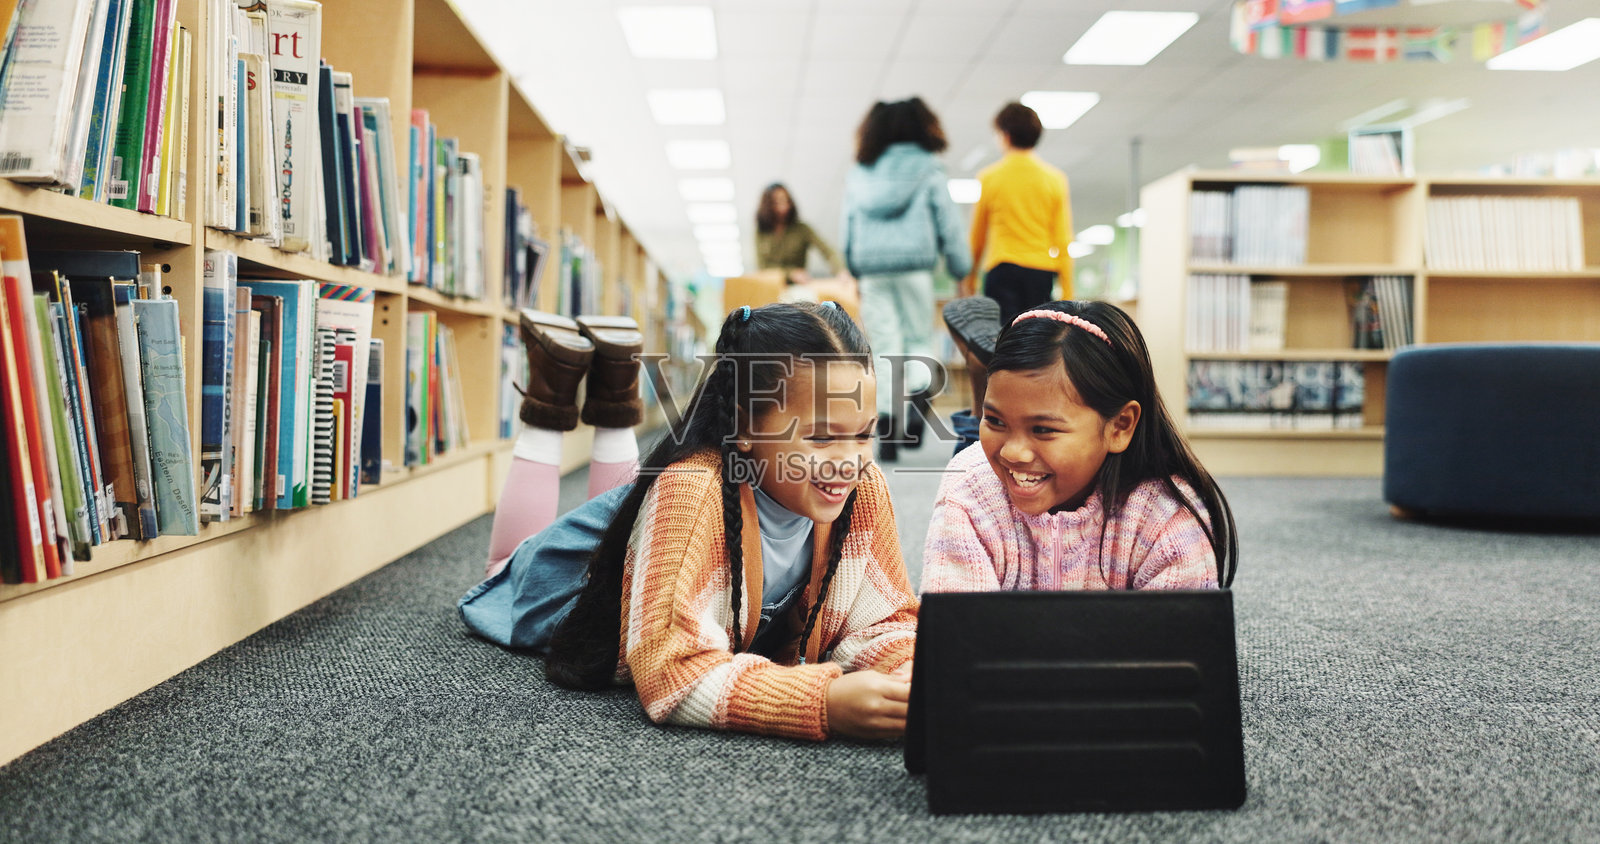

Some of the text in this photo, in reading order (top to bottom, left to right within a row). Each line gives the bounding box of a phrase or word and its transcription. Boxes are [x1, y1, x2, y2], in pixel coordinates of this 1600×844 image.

[271, 31, 304, 59] rt
[224, 372, 233, 437] BOOK
[155, 450, 192, 515] Eastern Desert
